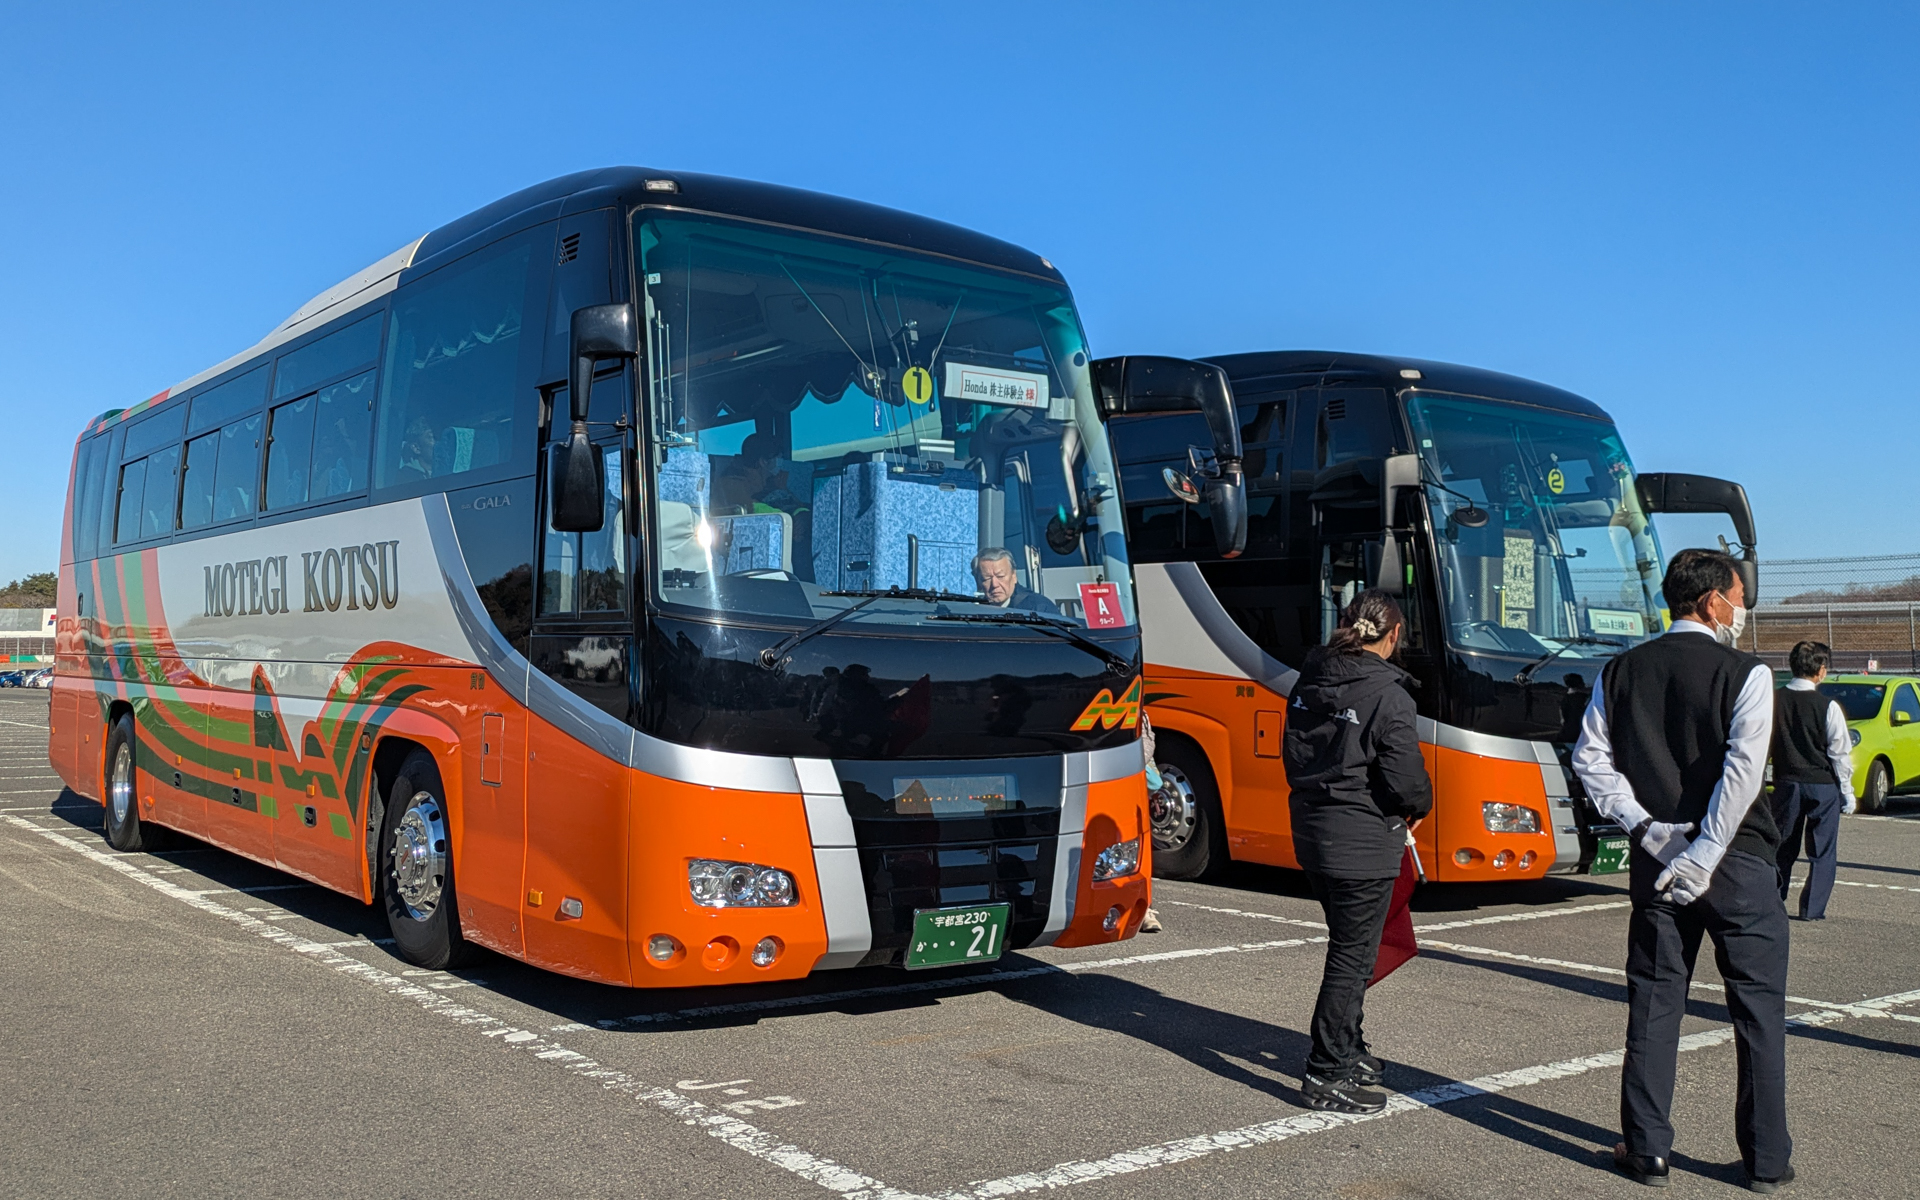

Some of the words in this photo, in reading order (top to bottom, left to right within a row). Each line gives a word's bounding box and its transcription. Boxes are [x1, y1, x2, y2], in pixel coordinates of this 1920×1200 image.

[912, 371, 923, 400] 1
[964, 379, 988, 395] Honda
[989, 382, 1024, 400] 株主体験会
[1551, 471, 1562, 489] 2
[473, 495, 511, 511] GALA
[203, 555, 290, 618] MOTEGI
[301, 540, 400, 613] KOTSU
[1098, 597, 1110, 615] A
[966, 923, 998, 958] 21
